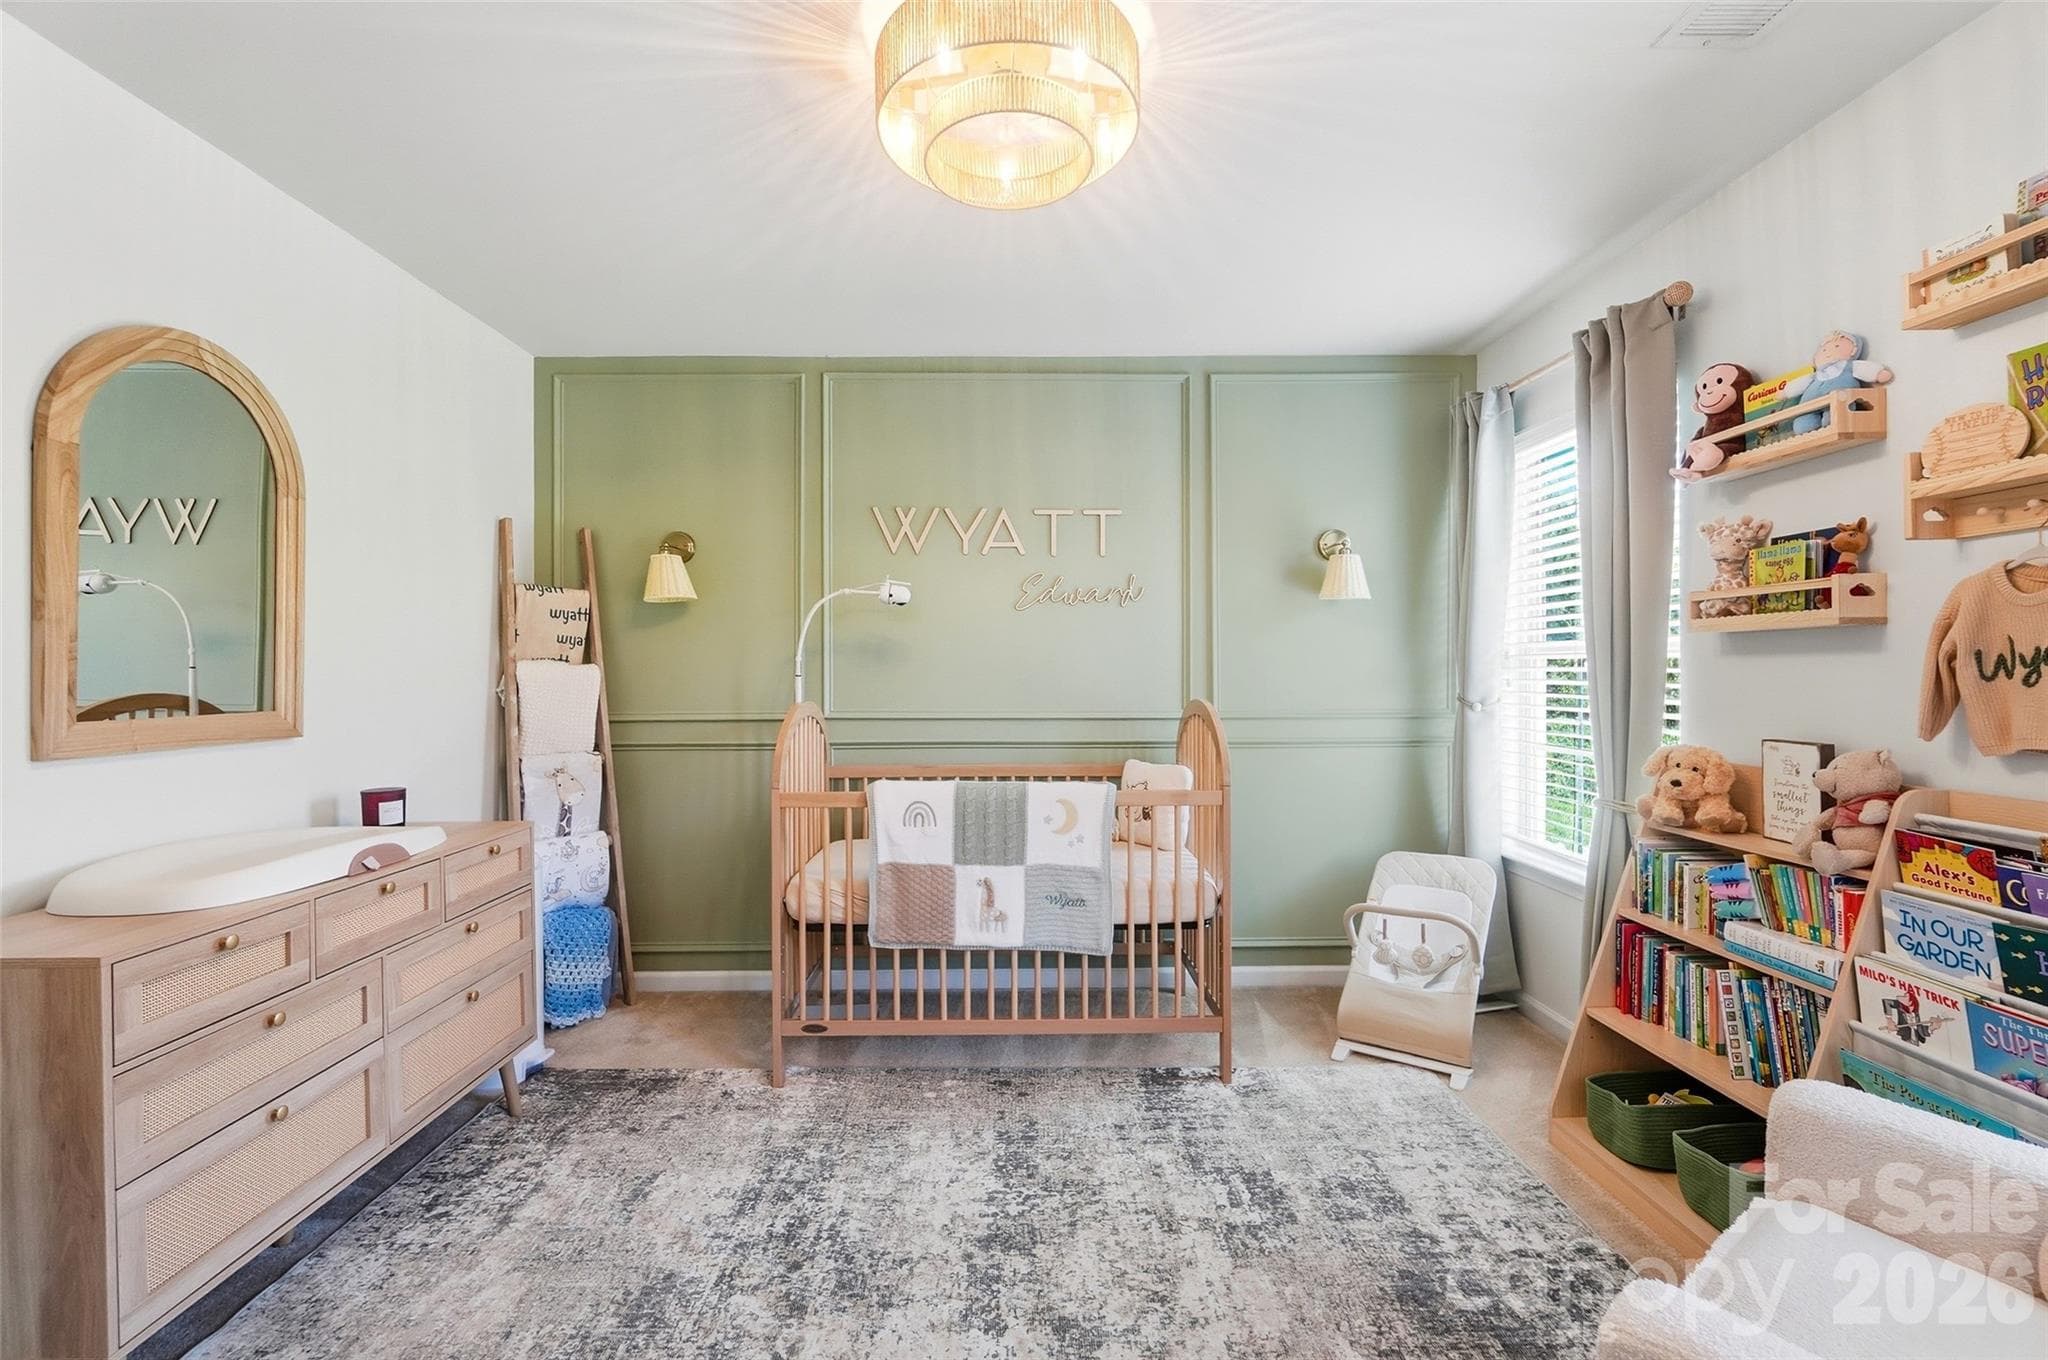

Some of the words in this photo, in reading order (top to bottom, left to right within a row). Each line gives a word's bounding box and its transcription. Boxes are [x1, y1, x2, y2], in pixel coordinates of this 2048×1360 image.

[2021, 352, 2048, 385] H
[2025, 384, 2048, 410] R
[871, 505, 1123, 557] WYATT
[1015, 571, 1144, 611] Edward
[550, 607, 590, 625] wyatt
[1776, 799, 1808, 818] things
[1911, 873, 1941, 888] Good
[1944, 882, 1993, 904] Fortune
[1924, 861, 1976, 886] Alex's
[1899, 909, 1927, 936] IN
[1930, 919, 1984, 952] OUR
[1897, 933, 1993, 981] GARDEN
[1858, 965, 1896, 988] MILO'S
[1899, 979, 1922, 998] HAT
[1922, 989, 1961, 1012] TRICK
[1998, 1015, 2024, 1032] The
[1869, 1069, 1896, 1093] The
[1900, 1084, 1924, 1106] Poo
